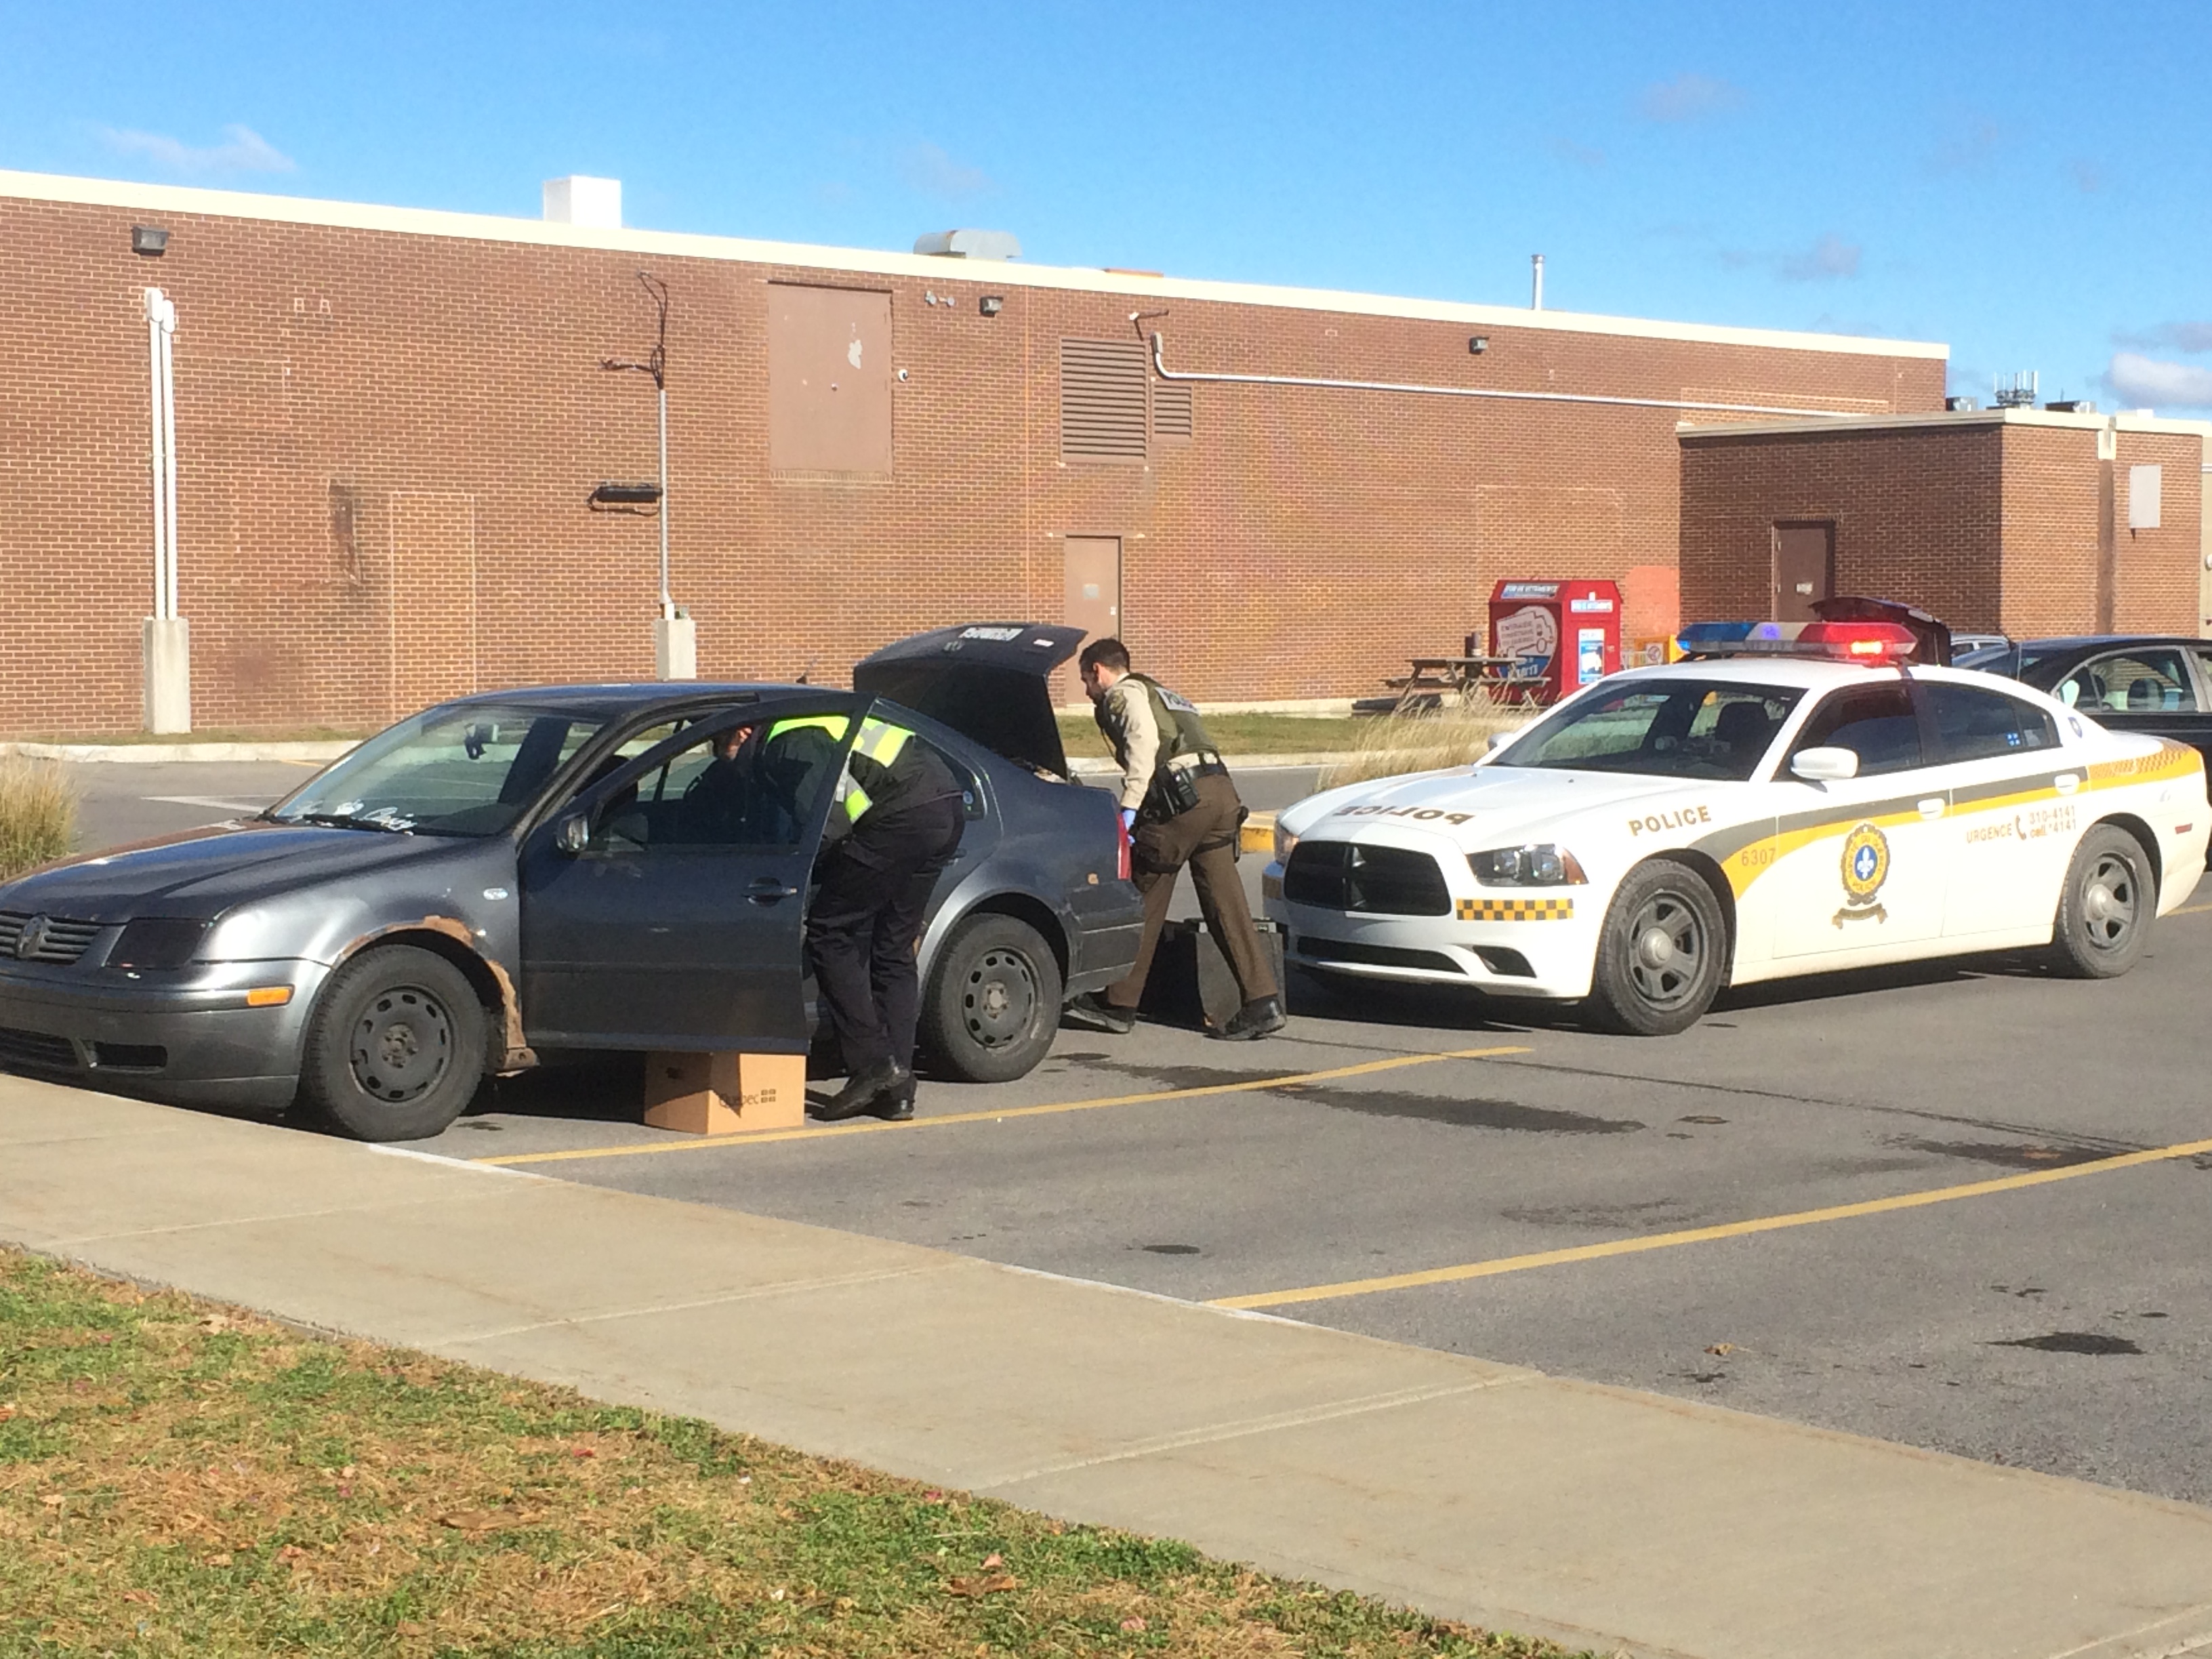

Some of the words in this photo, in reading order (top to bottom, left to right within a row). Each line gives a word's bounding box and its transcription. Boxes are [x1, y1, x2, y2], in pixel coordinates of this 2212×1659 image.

[1629, 805, 1711, 836] POLICE
[2029, 804, 2076, 825] 310-4141
[1967, 823, 2012, 844] URGENCE
[1741, 847, 1776, 866] 6307
